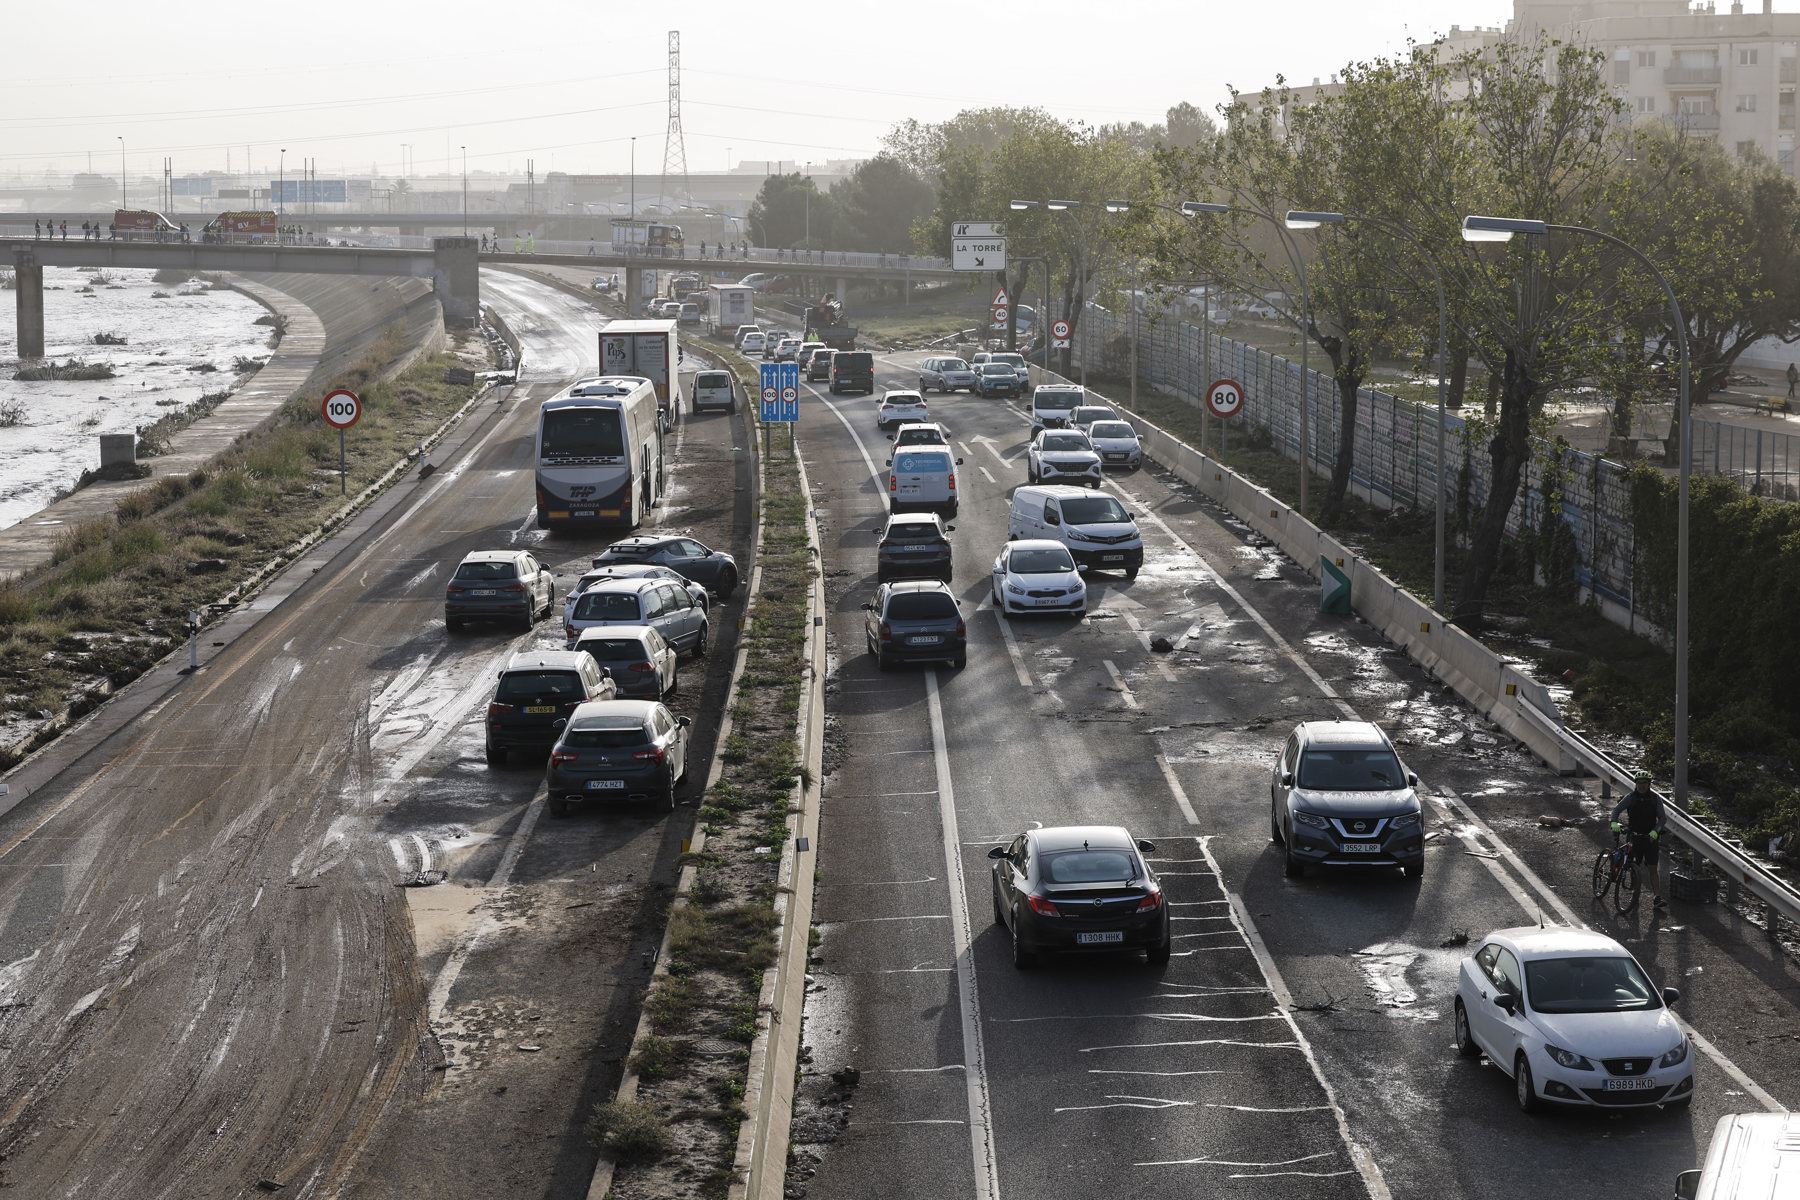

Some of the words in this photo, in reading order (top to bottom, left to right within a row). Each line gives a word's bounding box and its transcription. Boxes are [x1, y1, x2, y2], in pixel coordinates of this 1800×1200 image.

[1214, 392, 1237, 405] 80
[329, 402, 355, 416] 100
[1344, 844, 1362, 852] 3552
[1364, 844, 1378, 852] LRP
[1083, 934, 1104, 942] 1308
[1105, 933, 1121, 941] HHK
[1609, 1080, 1633, 1090] 6989
[1635, 1079, 1653, 1089] HKD
